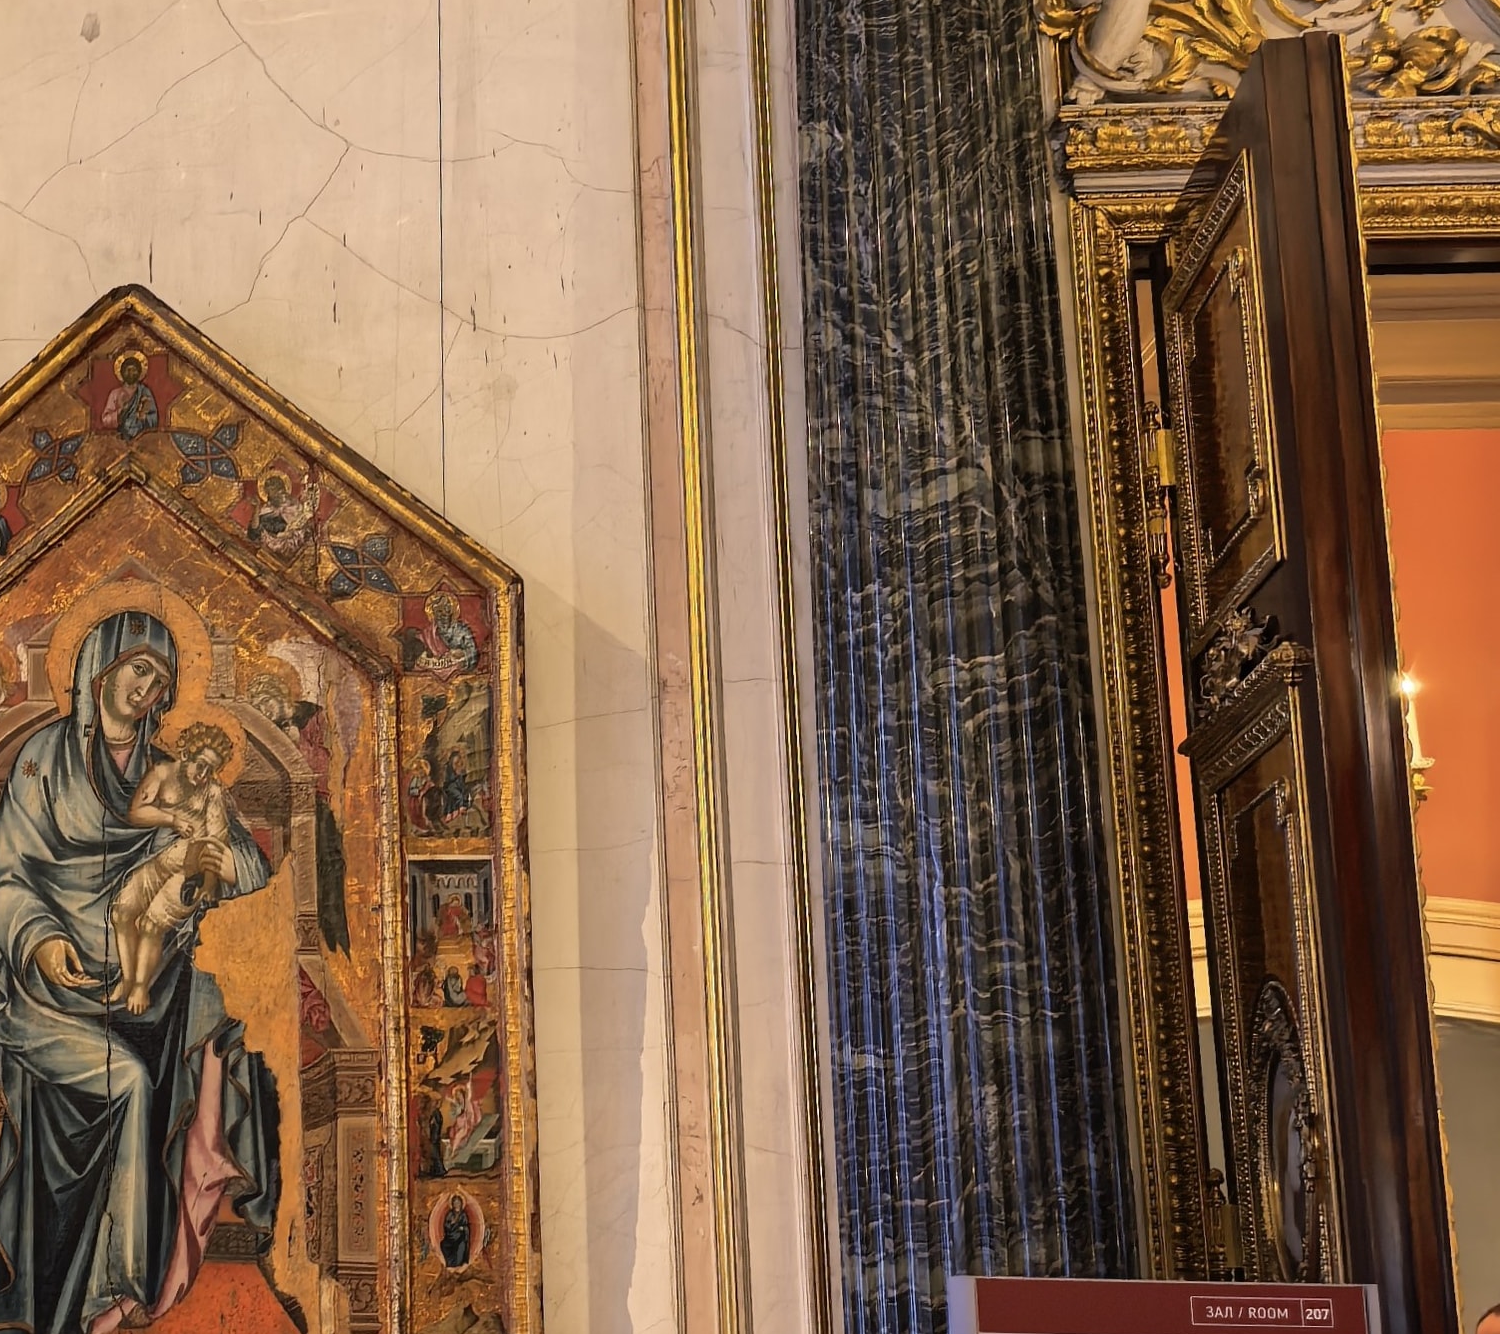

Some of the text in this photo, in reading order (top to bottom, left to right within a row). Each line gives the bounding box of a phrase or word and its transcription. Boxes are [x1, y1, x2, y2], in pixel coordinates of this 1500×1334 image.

[1206, 1306, 1233, 1318] ЗАЛ
[1249, 1307, 1288, 1319] ROOM
[1306, 1309, 1329, 1319] 207
